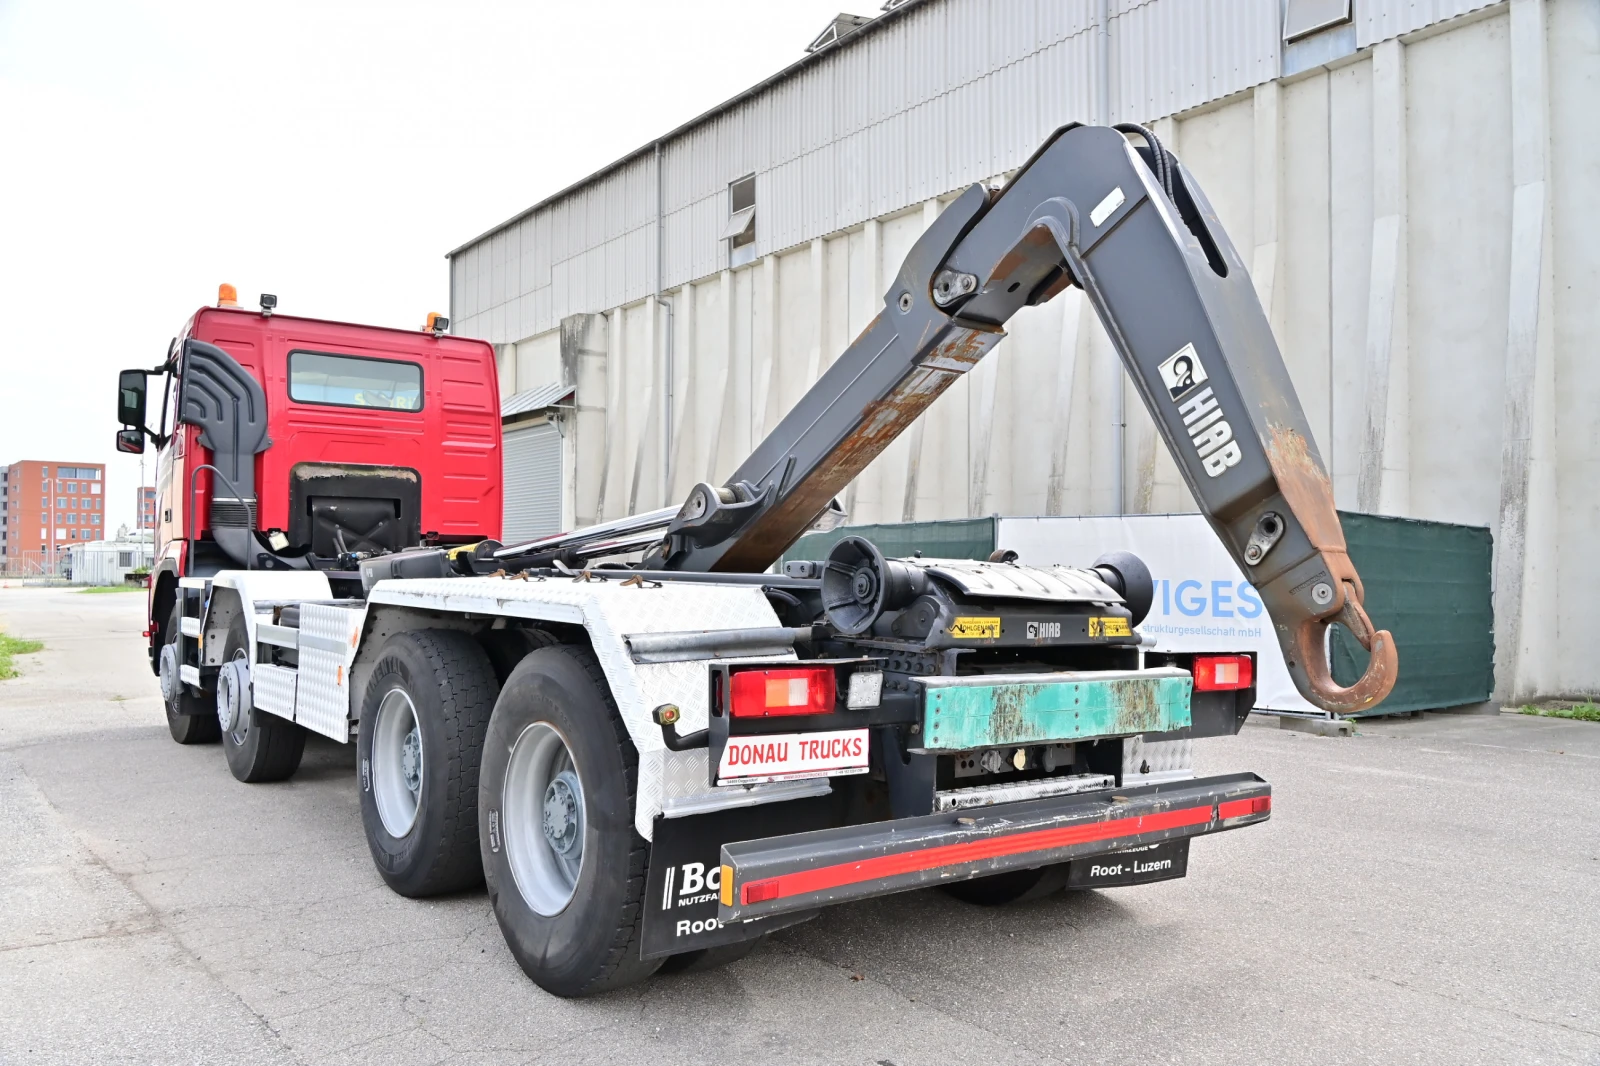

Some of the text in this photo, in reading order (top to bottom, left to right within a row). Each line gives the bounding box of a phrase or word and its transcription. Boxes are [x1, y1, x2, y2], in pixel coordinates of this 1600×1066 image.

[1178, 386, 1242, 477] HIAB
[1039, 622, 1061, 638] HIAB
[1238, 628, 1261, 638] mbH
[728, 737, 862, 766] DONAU TRUCKS
[1090, 863, 1122, 877] Root
[1133, 859, 1171, 874] Luzern
[678, 892, 720, 907] NUTZFA
